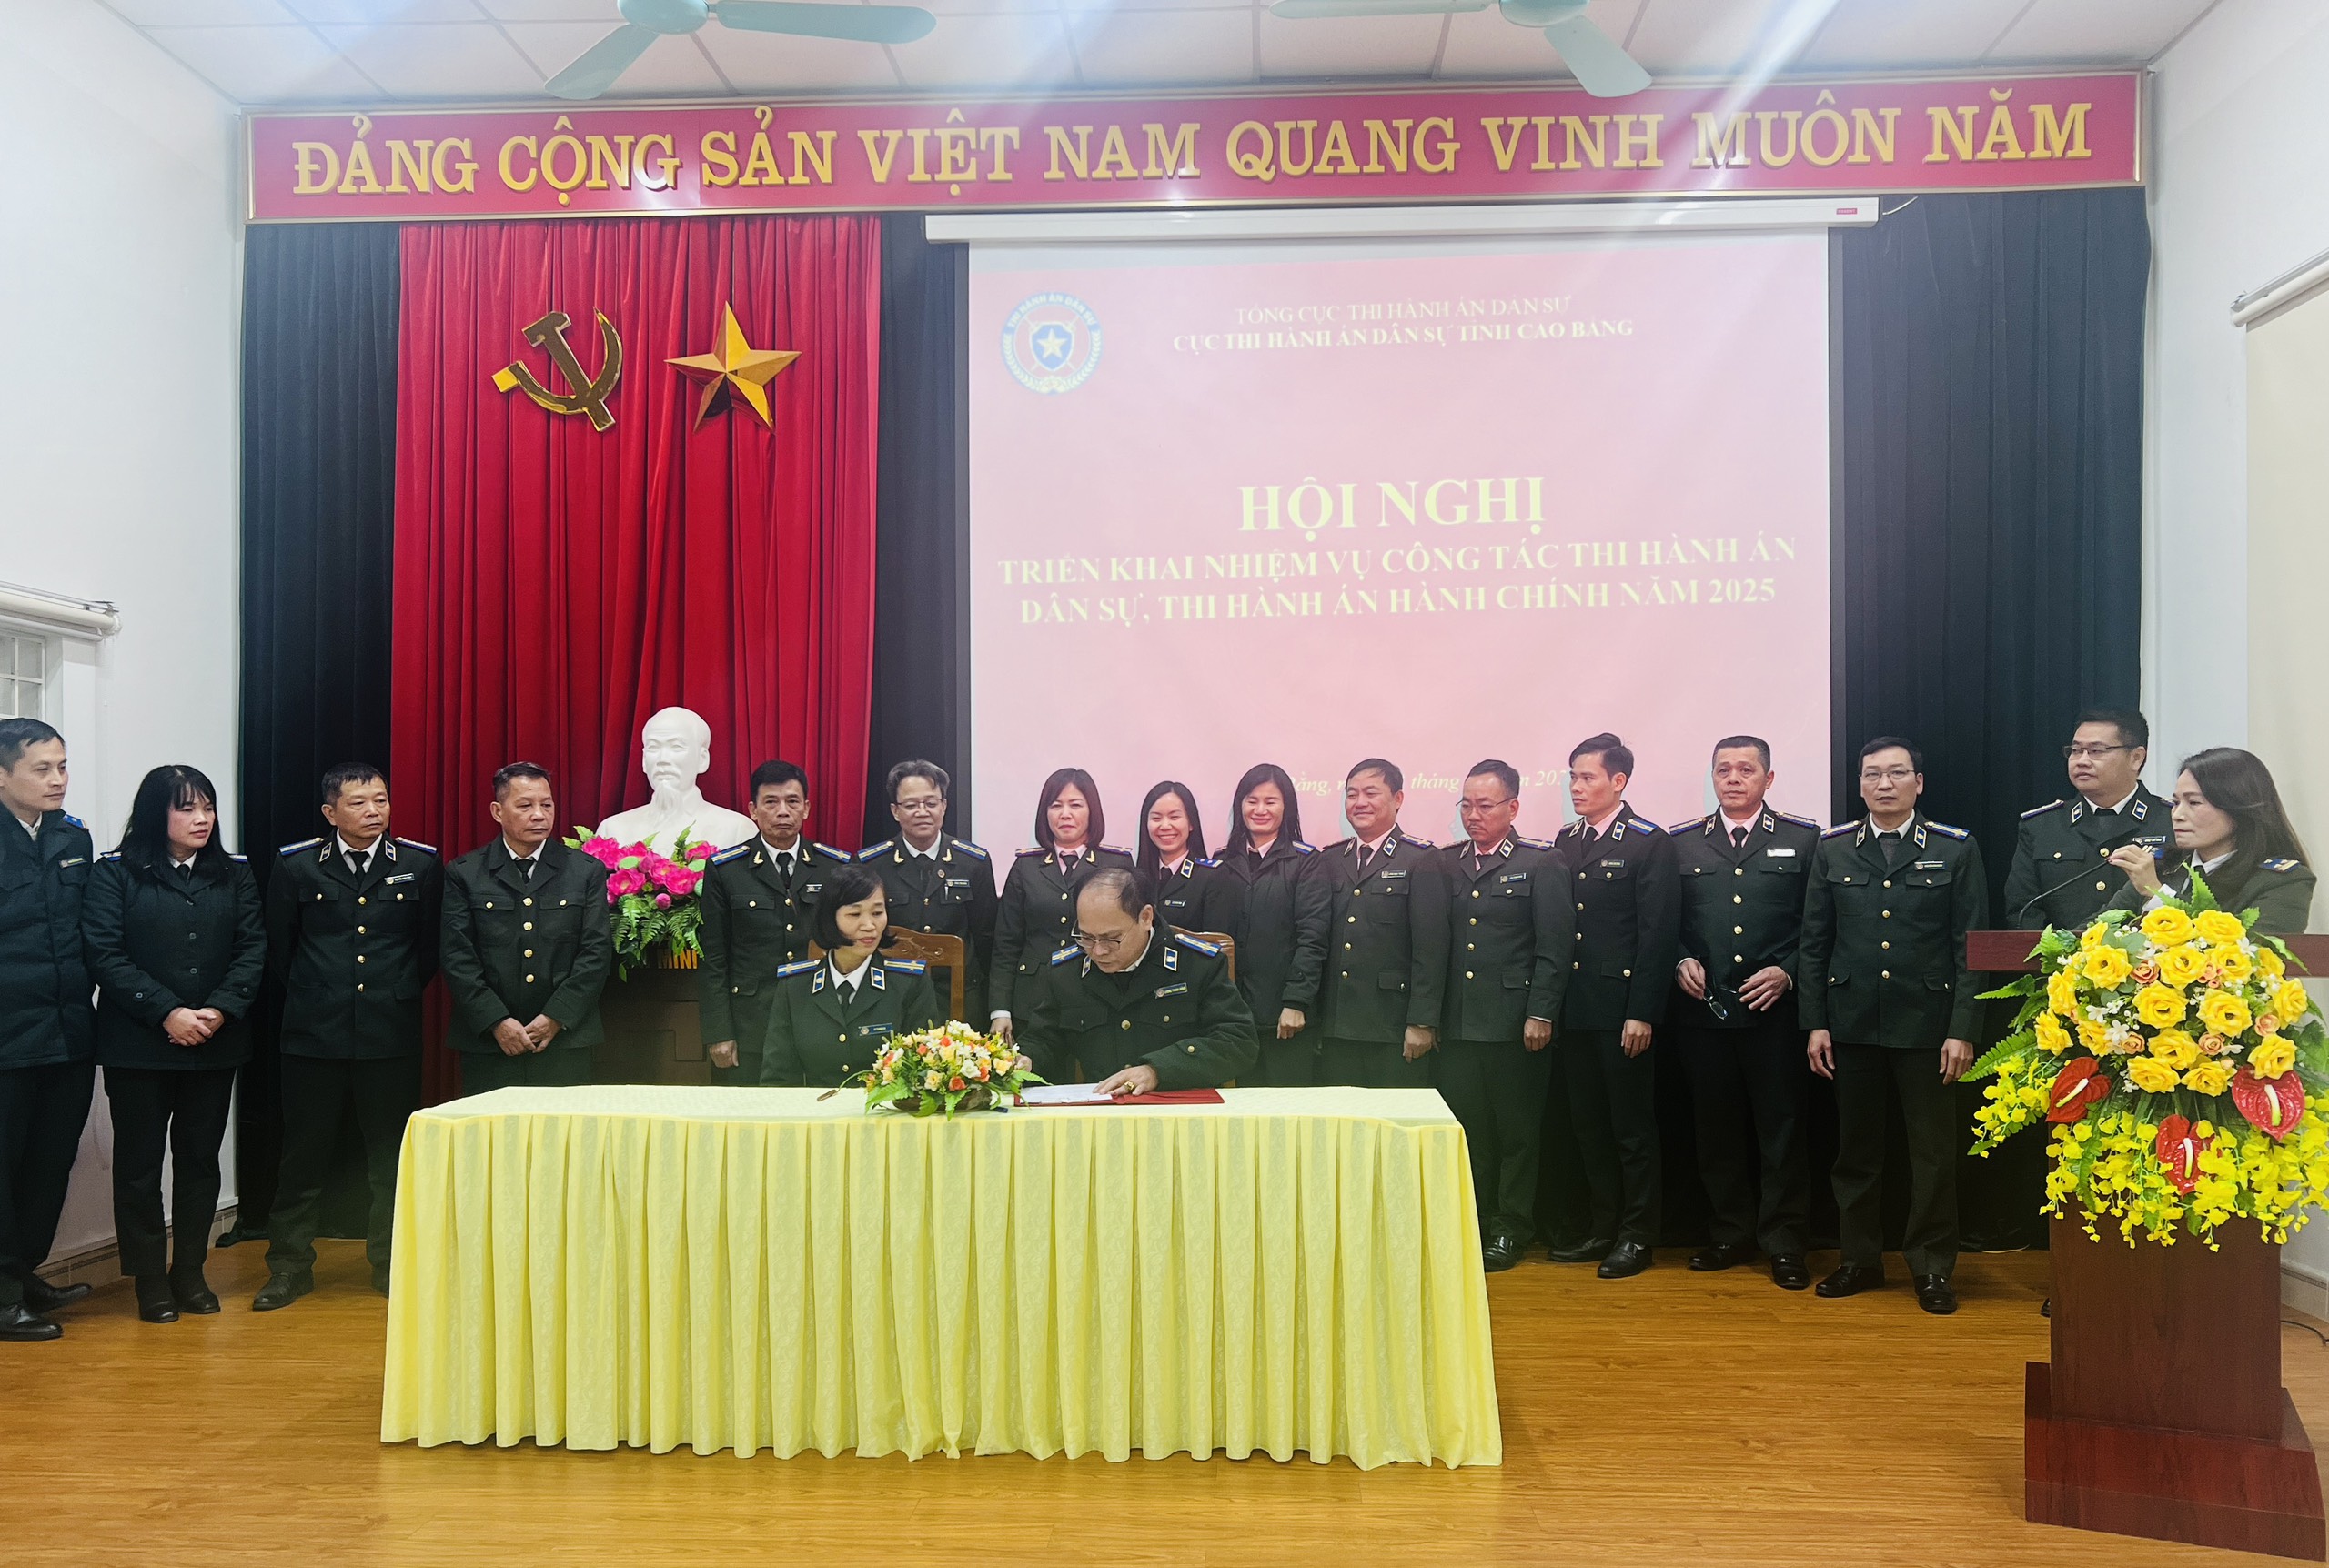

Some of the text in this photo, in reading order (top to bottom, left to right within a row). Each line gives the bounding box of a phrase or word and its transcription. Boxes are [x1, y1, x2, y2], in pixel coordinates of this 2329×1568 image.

[292, 86, 2092, 206] ĐẢNG CỘNG SẢN VIỆT NAM QUANG VINH MUÔN NĂM
[1298, 305, 1340, 325] CỤC
[1346, 304, 1381, 320] THI
[1387, 298, 1450, 319] HÀNH
[1173, 333, 1220, 355] CỤC
[1224, 332, 1261, 349] THI
[1268, 327, 1332, 348] HÀNH
[1336, 324, 1366, 346] ÁN
[1372, 322, 1418, 344] DÂN
[1424, 323, 1453, 347] SỰ
[1517, 322, 1565, 339] CAO
[1237, 476, 1545, 542] HỘI NGHỊ
[997, 529, 1796, 585] TRIỂN KHAI NHIỆM VỤ CÔNG TÁC THI HÀNH ÁN
[1020, 575, 1776, 628] DÂN SỰ, THI HÀNH ÁN HÀNH CHÍNH NĂM 2025
[1411, 771, 1461, 794] tháng
